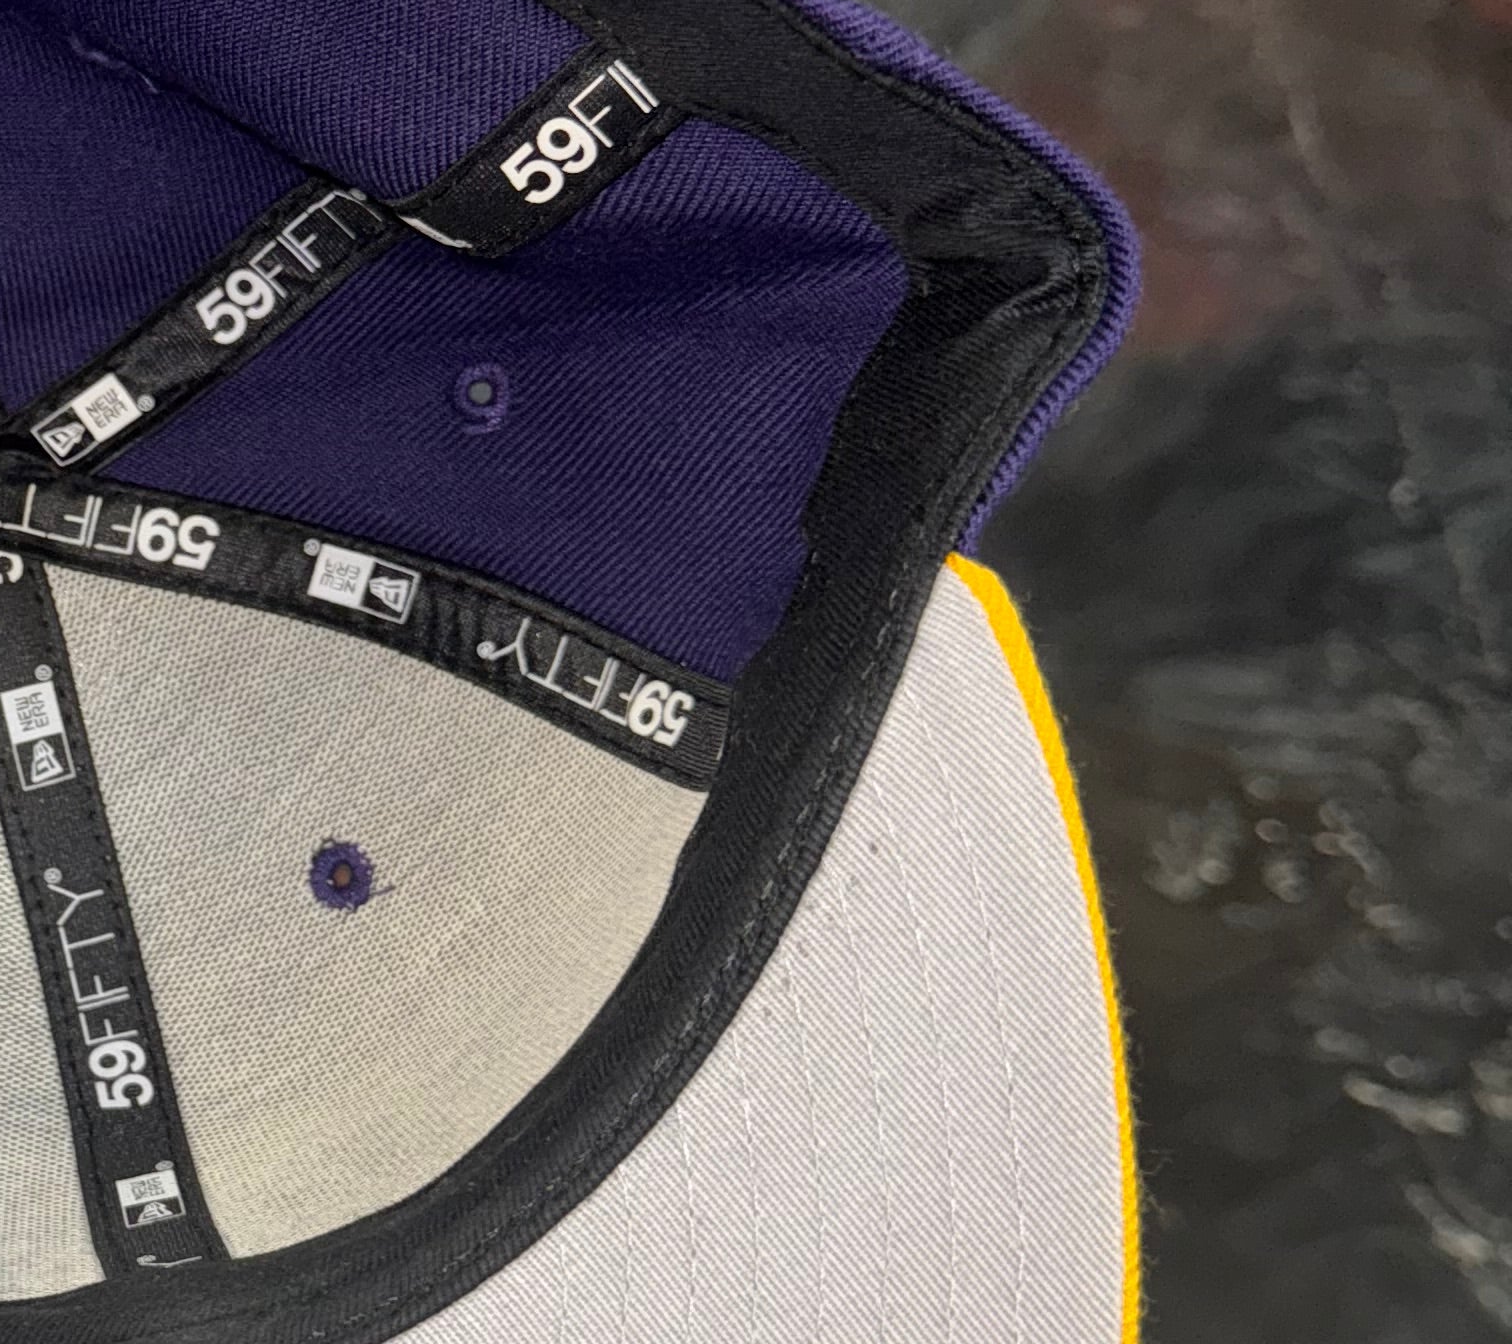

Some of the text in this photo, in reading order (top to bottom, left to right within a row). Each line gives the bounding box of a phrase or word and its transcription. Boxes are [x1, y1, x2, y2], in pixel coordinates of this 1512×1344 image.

[85, 388, 119, 418] NEW
[94, 400, 128, 429] ERA
[319, 572, 355, 594] NEW
[324, 558, 360, 580] ERA
[492, 617, 695, 747] 59FIFTY
[14, 695, 35, 732] NEW
[28, 691, 50, 728] ERA
[47, 884, 153, 1109] 59FIFTY
